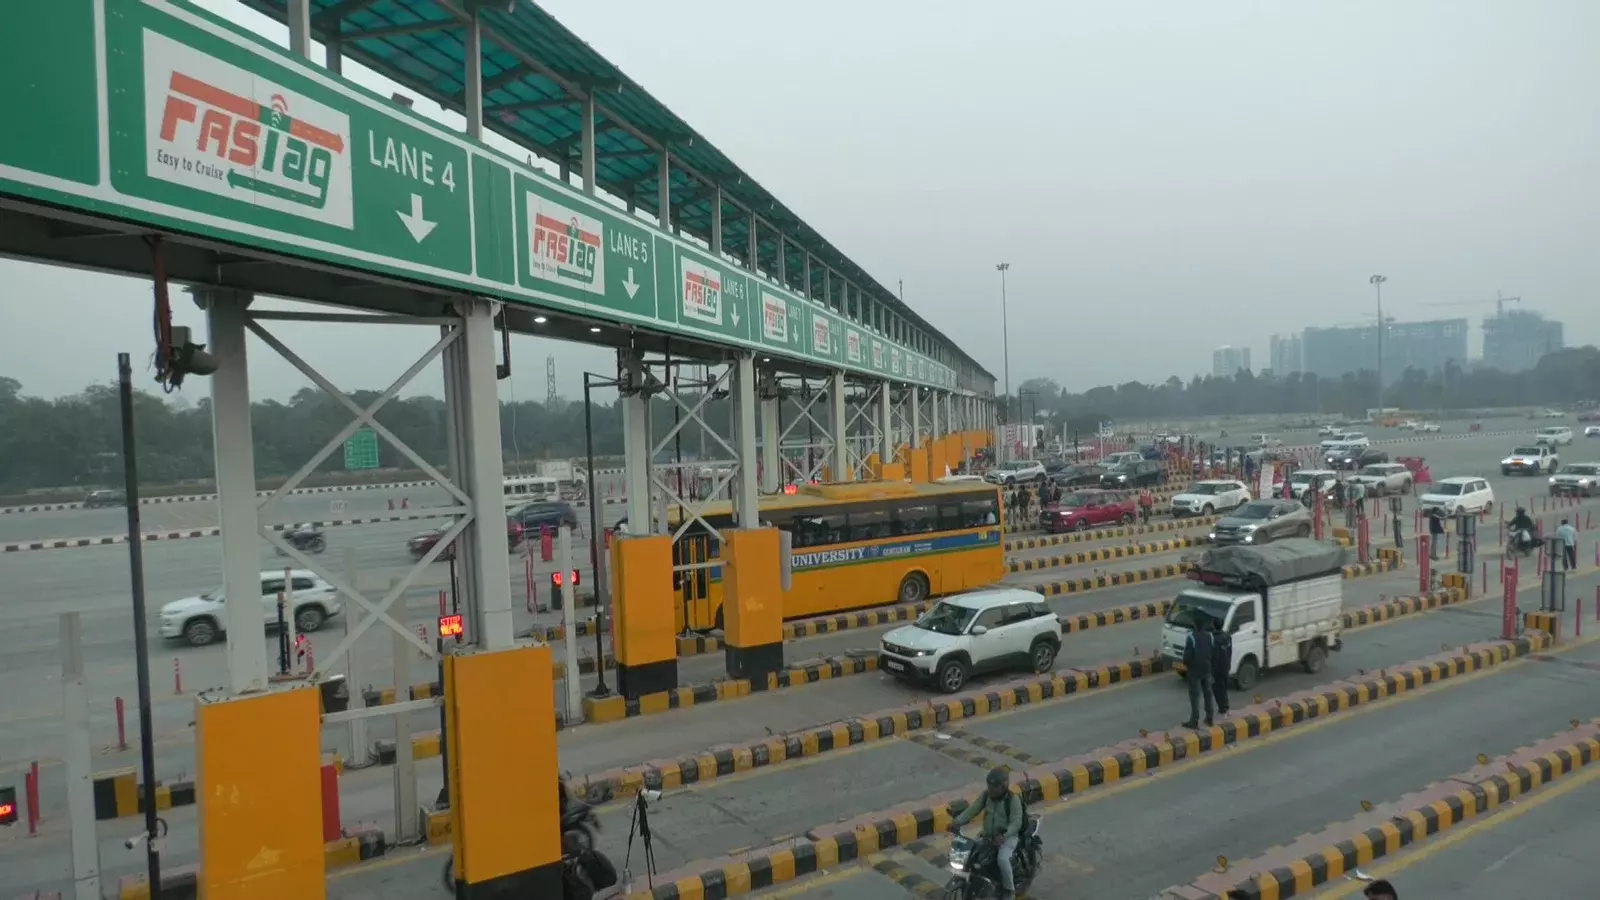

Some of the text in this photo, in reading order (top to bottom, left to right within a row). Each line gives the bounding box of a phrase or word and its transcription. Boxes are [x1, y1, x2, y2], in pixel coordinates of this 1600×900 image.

[157, 149, 223, 180] Easy to Cruise
[369, 129, 456, 193] LANE 4
[610, 229, 648, 264] LANE 5
[792, 547, 866, 568] UNIVERSITY
